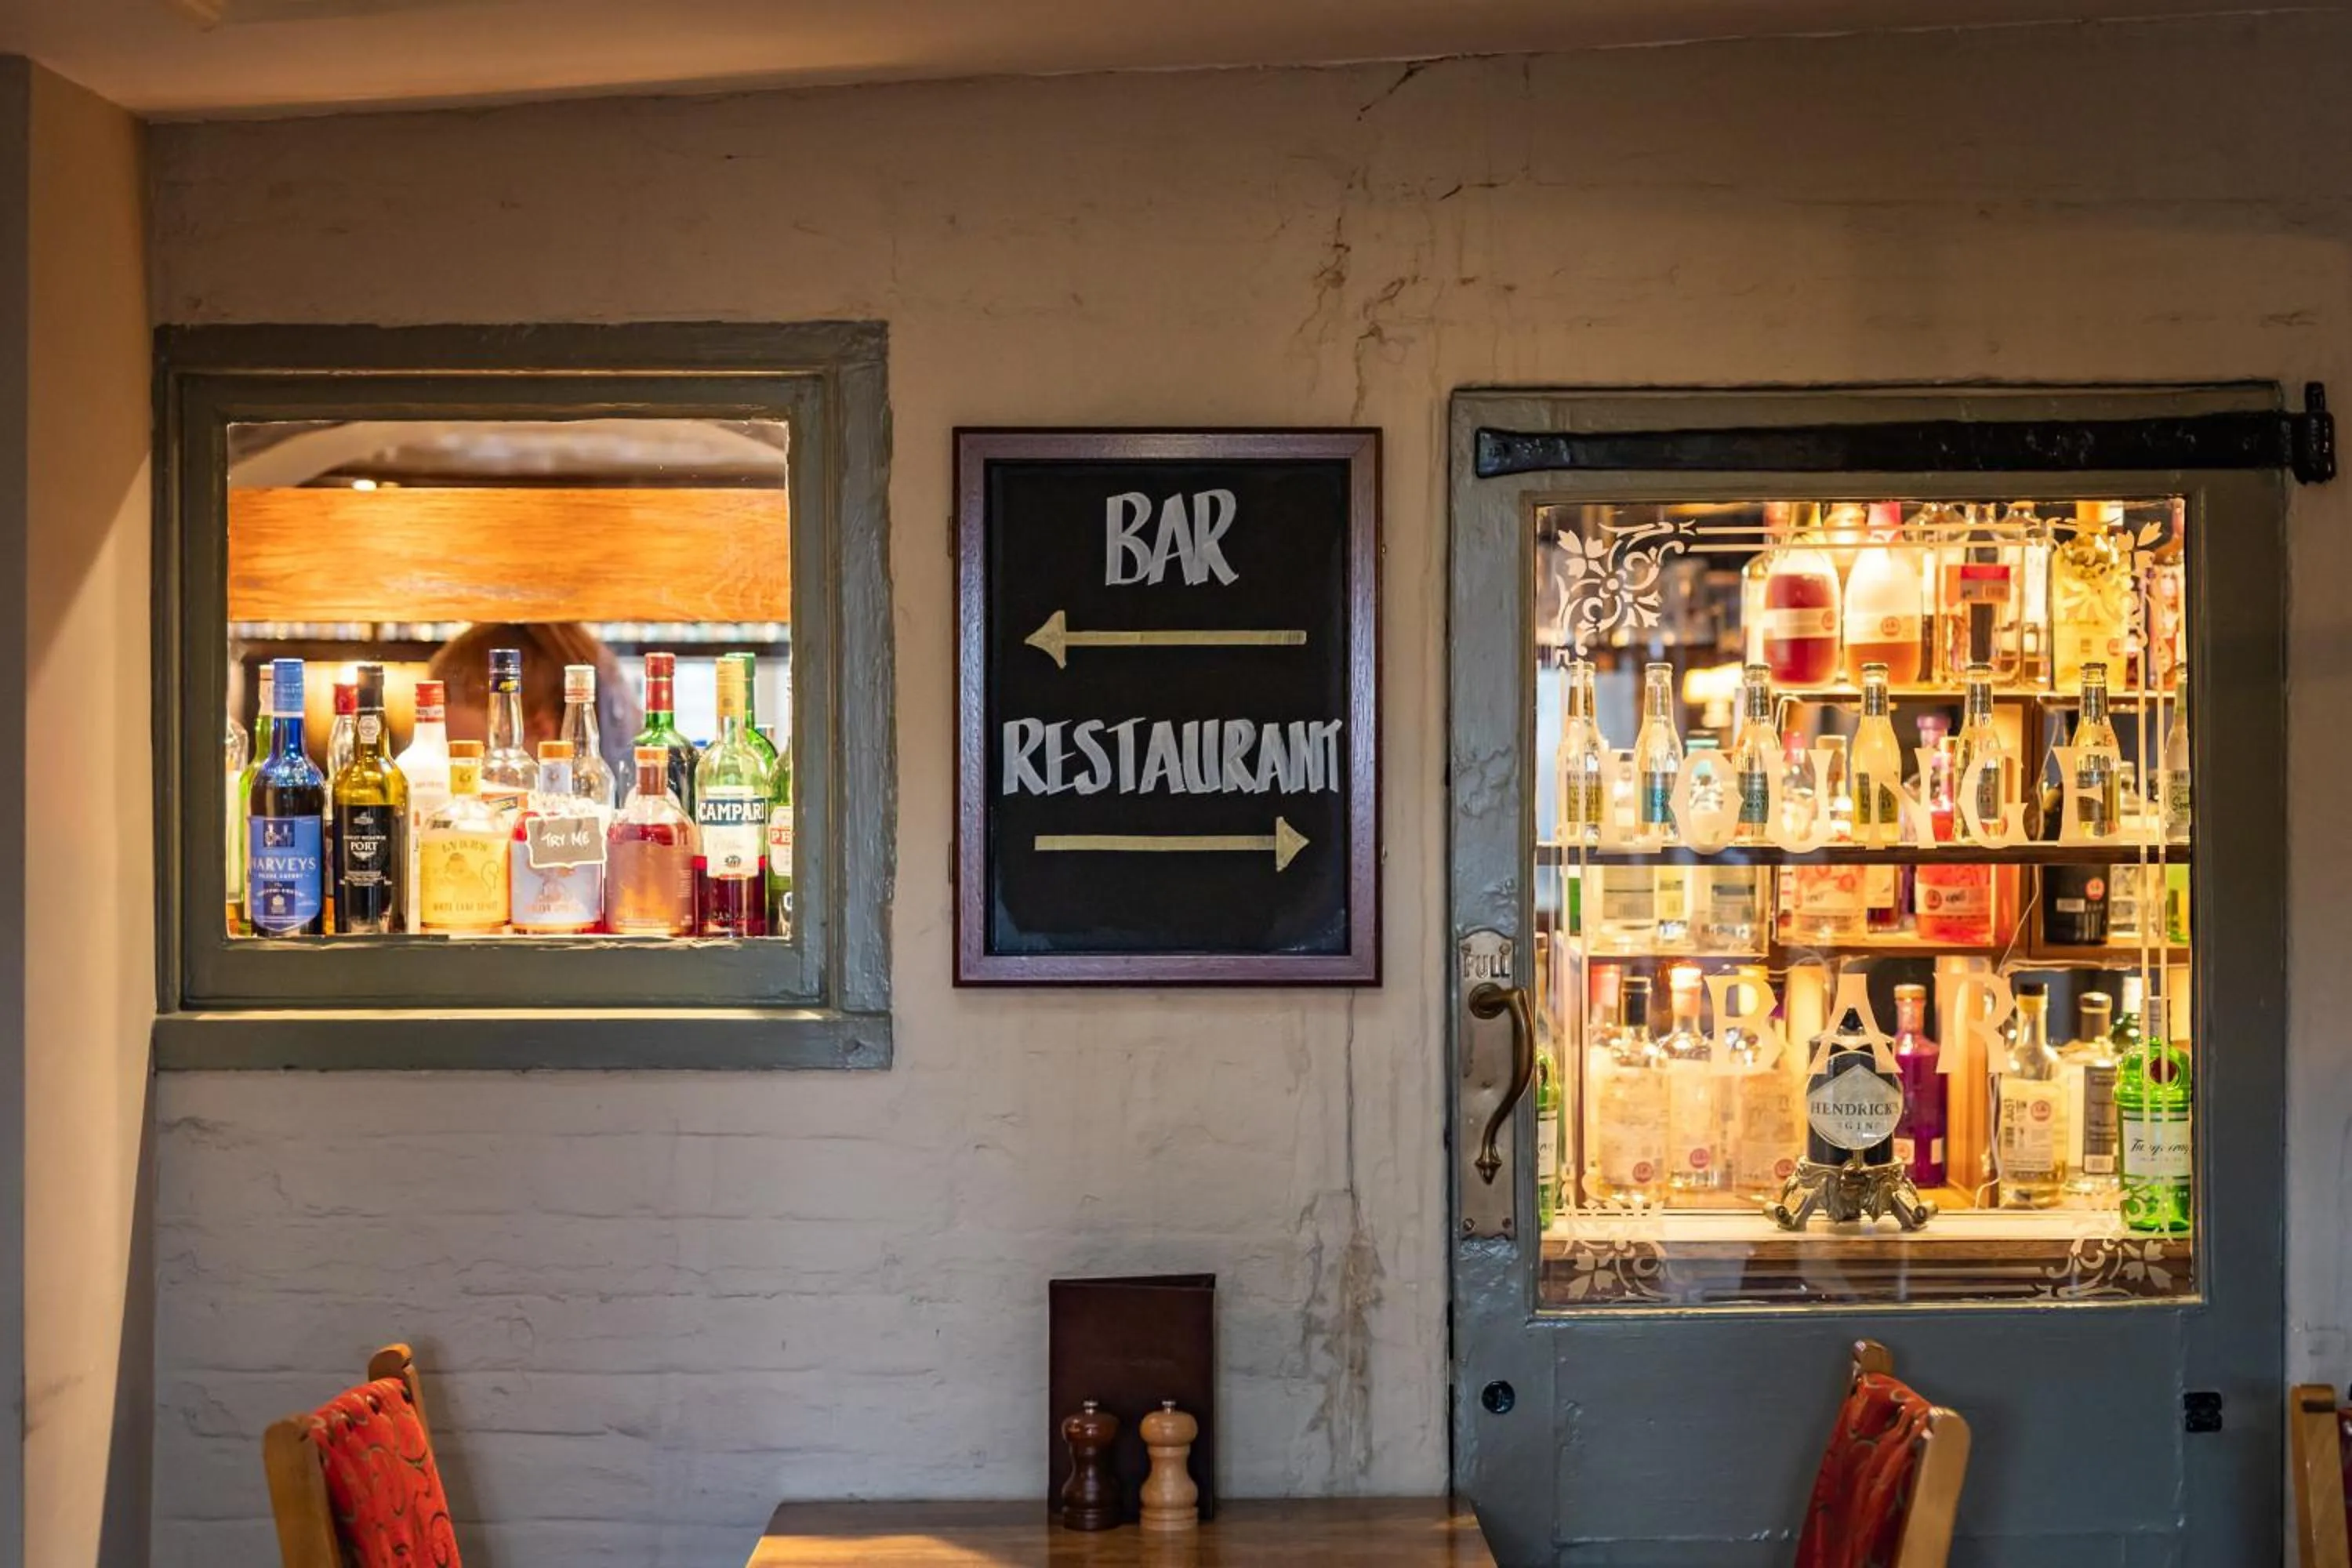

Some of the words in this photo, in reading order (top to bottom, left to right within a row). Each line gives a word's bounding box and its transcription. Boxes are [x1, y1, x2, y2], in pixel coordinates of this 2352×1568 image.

[1105, 488, 1240, 586] BAR
[1002, 717, 1343, 796] RESTAURANT
[699, 801, 764, 822] CAMPARI
[1596, 746, 2128, 855] LOUNGE
[350, 841, 378, 851] PORT
[541, 833, 565, 847] TRY
[571, 831, 590, 846] ME
[1464, 953, 1511, 978] PULL
[1705, 972, 2017, 1074] BAR
[1844, 1121, 1874, 1130] GIN
